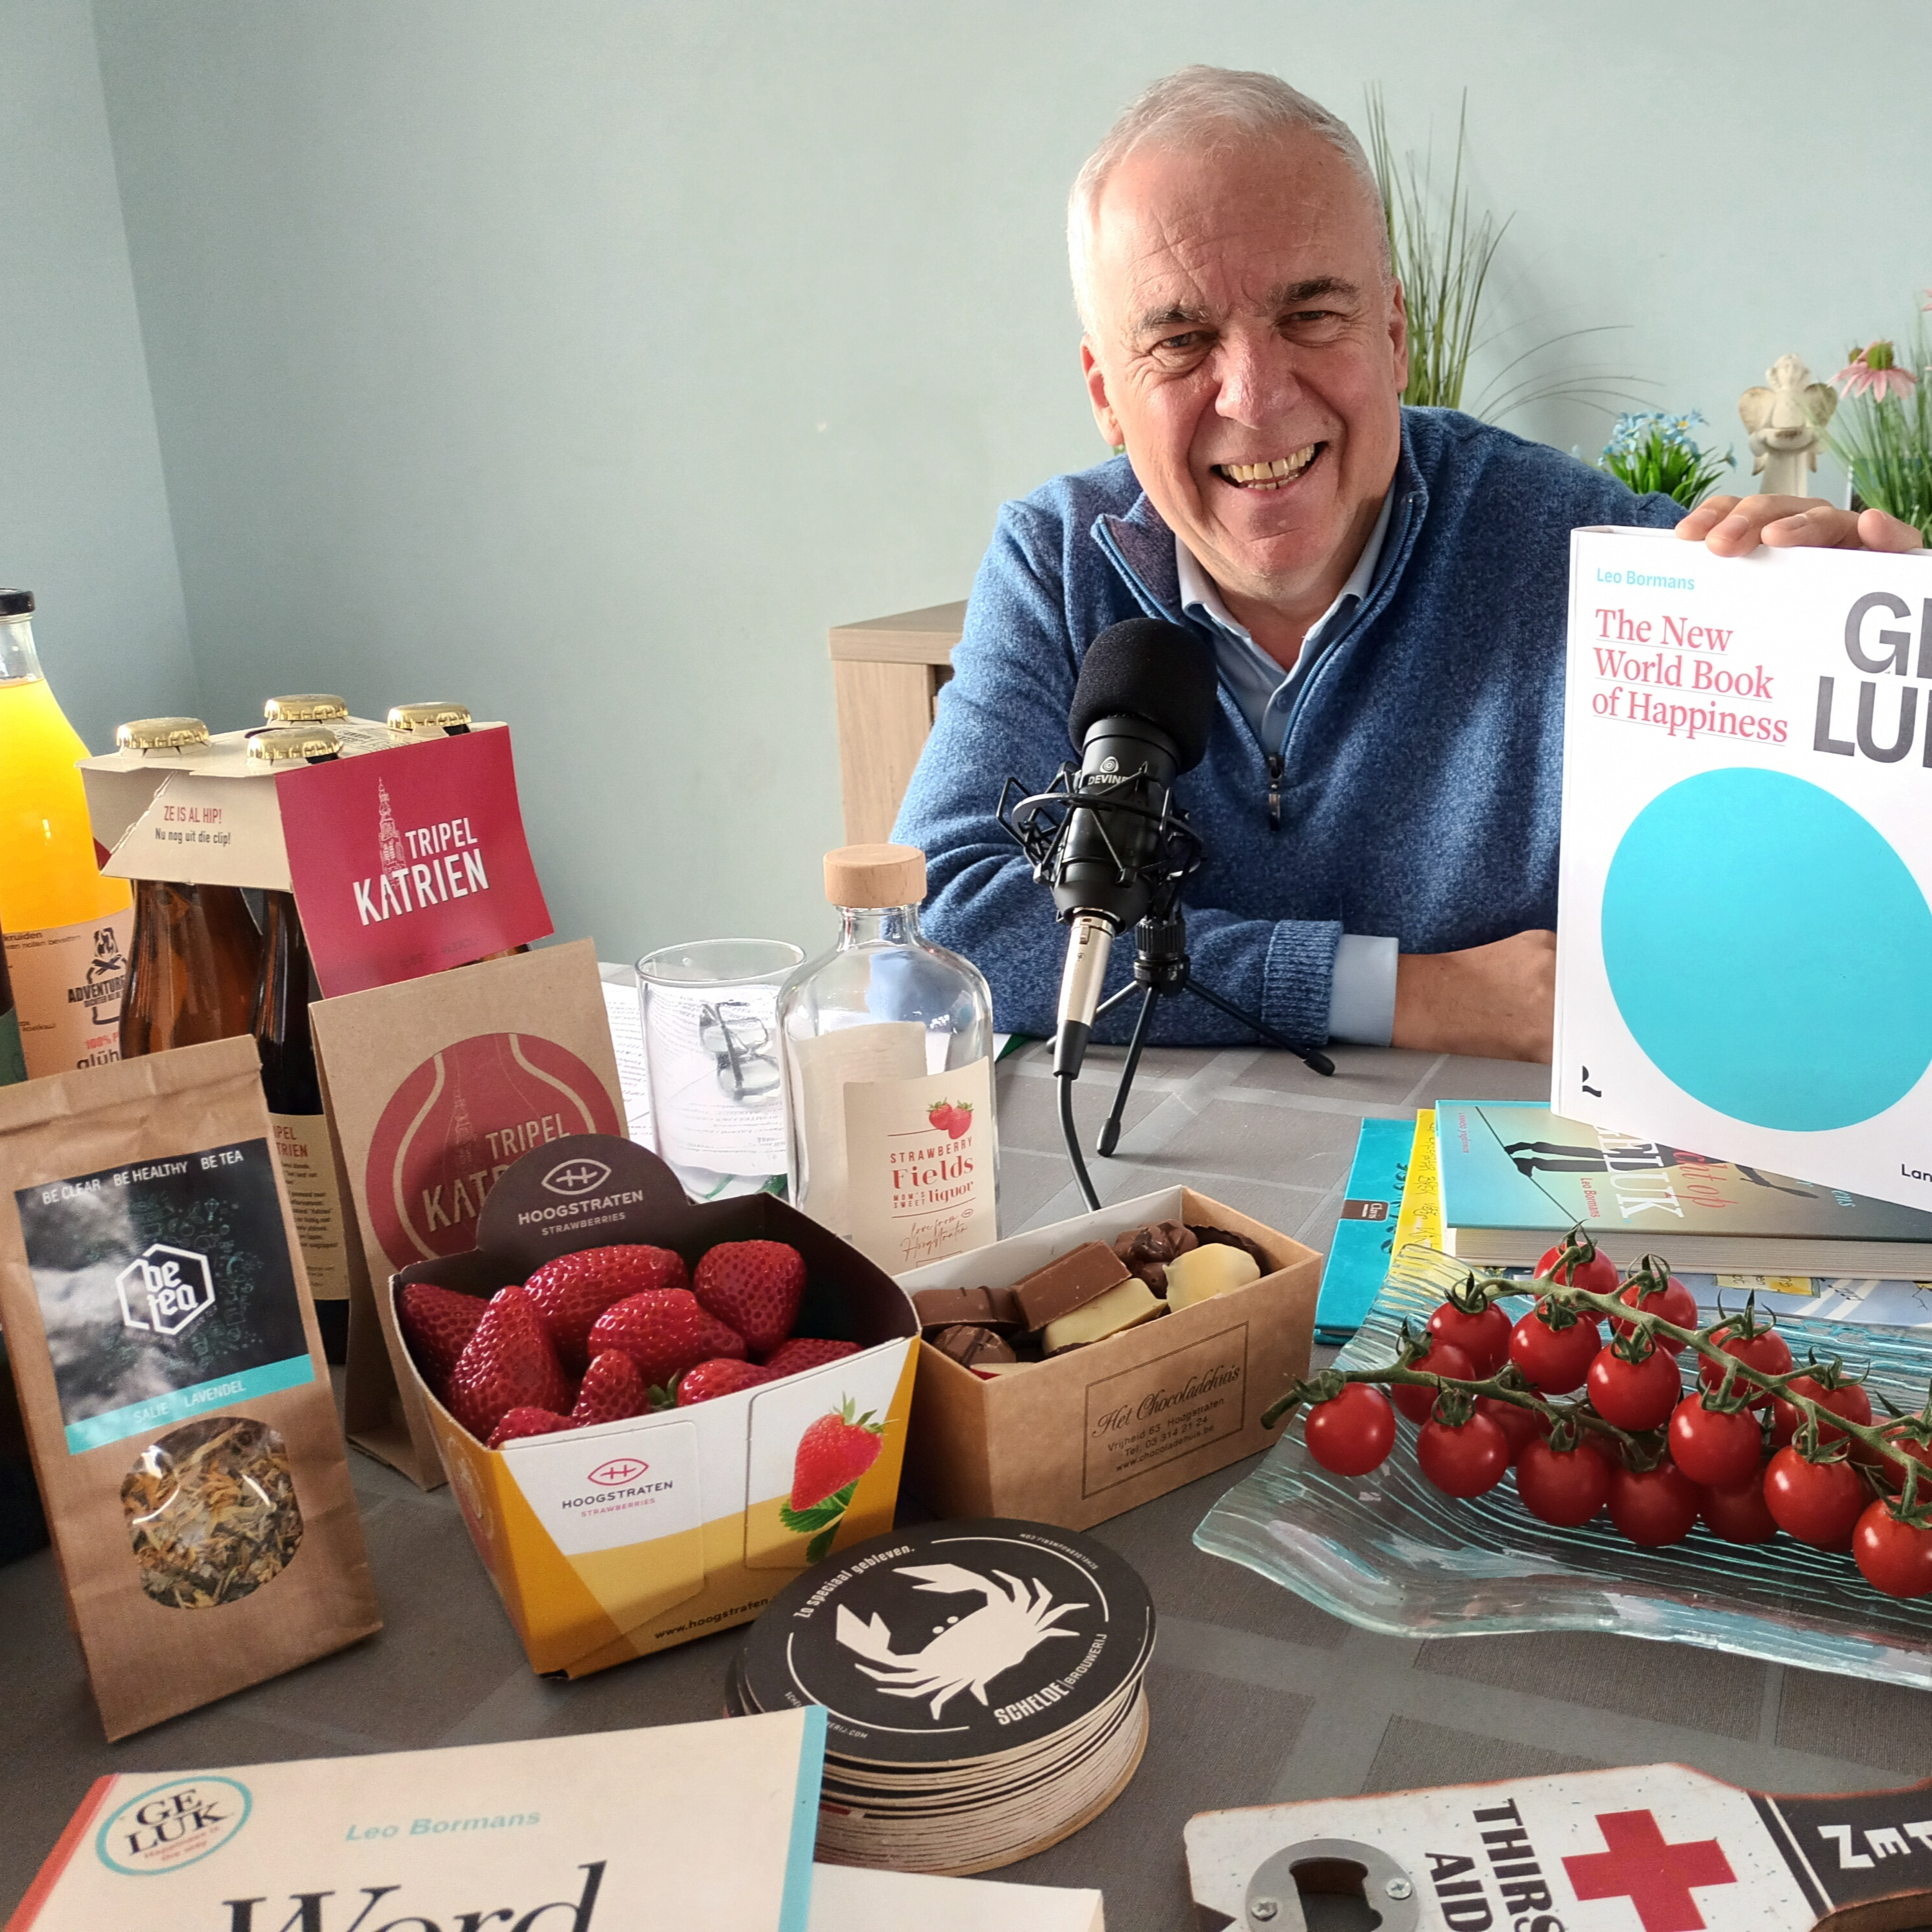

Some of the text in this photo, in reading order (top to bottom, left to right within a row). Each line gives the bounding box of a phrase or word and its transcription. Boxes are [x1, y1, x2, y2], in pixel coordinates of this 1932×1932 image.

[1596, 567, 1695, 591] Leo Bormans
[1595, 609, 1734, 651] The New
[1593, 647, 1774, 699] World Book
[1592, 687, 1788, 743] of Happiness
[1813, 676, 1932, 768] LU
[164, 805, 222, 824] ZE IS AL HIP!
[155, 828, 231, 847] Nu nog uit die clip!
[404, 817, 478, 859] TRIPEL
[352, 848, 489, 926] KATRIEN
[485, 1113, 571, 1160] TRIPEL
[890, 1136, 972, 1164] STRAWBERRY
[42, 1150, 244, 1205] BE CLEAR BE HEALTHY BE TEA
[891, 1155, 974, 1189] Fields
[928, 1181, 974, 1203] liquor
[422, 1164, 511, 1232] KAT
[518, 1189, 645, 1225] HOOGSTRATEN
[893, 1198, 925, 1209] SWEET
[1368, 1203, 1383, 1218] Clavis
[1580, 1177, 1600, 1218] Leo Bormans
[542, 1212, 626, 1236] STRAWBERRIES
[184, 1380, 247, 1407] LAVENDEL
[1092, 1364, 1241, 1438] Het Chocoladehuis
[1108, 1397, 1224, 1452] Vrijheid 63 Hoogstraten
[1124, 1416, 1208, 1457] Tel. 03 314 21 24
[1116, 1425, 1214, 1472] www.chocoladehuis.be
[562, 1480, 674, 1510] HOOGSTRATEN
[581, 1497, 656, 1517] STRAWBERRIES
[806, 1569, 853, 1606] speciaal
[851, 1545, 915, 1575] gebleven.
[994, 1633, 1108, 1725] SCHELDE BROUWERIJ
[136, 1788, 202, 1825] GE
[345, 1810, 541, 1842] Leo Bormans
[124, 1801, 233, 1855] LUK
[1425, 1852, 1493, 1932] AID
